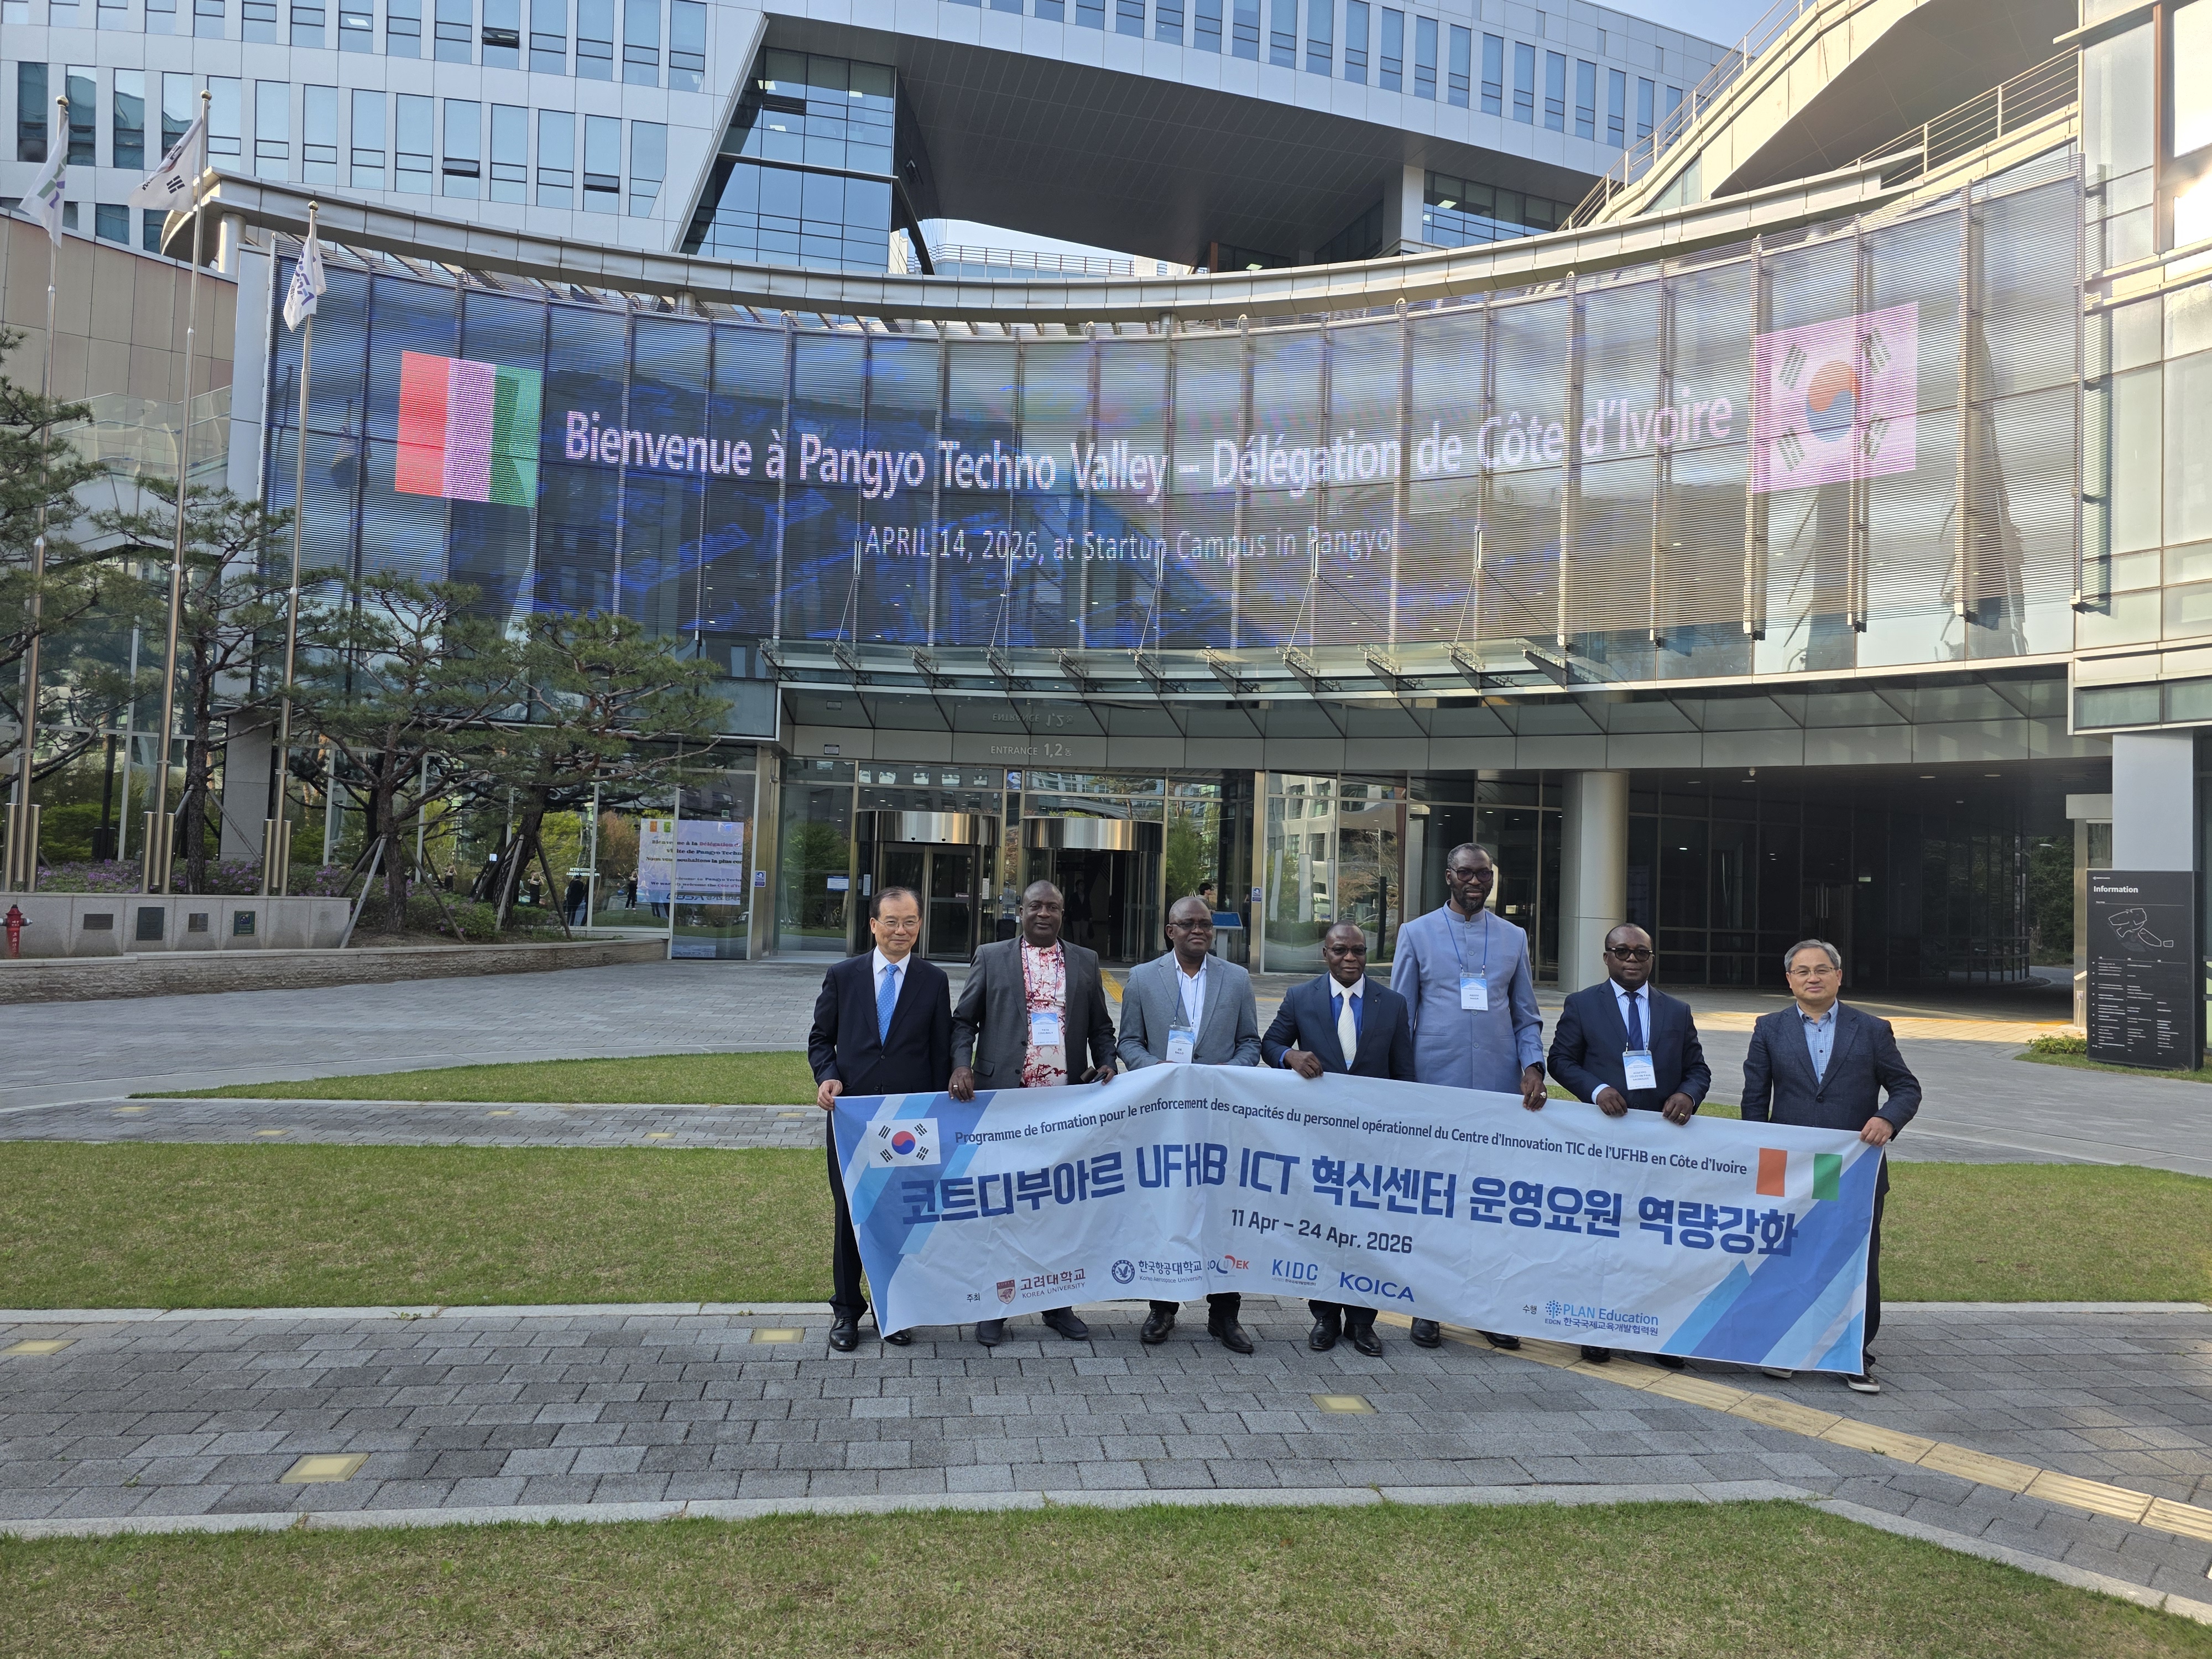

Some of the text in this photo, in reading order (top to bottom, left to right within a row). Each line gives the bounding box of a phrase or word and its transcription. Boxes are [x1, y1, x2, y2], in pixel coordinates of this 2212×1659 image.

[566, 410, 751, 477] Bienvenue
[765, 429, 785, 479] à
[800, 434, 925, 499] Pangyo
[941, 440, 1056, 491] Techno
[1071, 441, 1168, 502] Valley
[1213, 430, 1400, 498] Délégation
[1417, 420, 1463, 473] de
[1479, 413, 1563, 468] Côte
[1580, 387, 1732, 455] d'Ivoire
[865, 523, 1392, 568] APRIL 14, 2026, at Startup Campus in Pangyo
[990, 746, 1038, 755] ENTRANCE
[954, 1128, 1022, 1145] Programme
[1024, 1124, 1038, 1136] de
[1041, 1114, 1097, 1134] formation
[1099, 1110, 1126, 1126] pour
[1128, 1105, 1138, 1117] le
[1140, 1098, 1208, 1115] renforcement
[1211, 1098, 1230, 1112] des
[1232, 1104, 1285, 1120] capacités
[1287, 1108, 1301, 1122] du
[1303, 1113, 1360, 1129] personnel
[1362, 1118, 1432, 1138] opérationnel
[1434, 1126, 1448, 1140] du
[1451, 1128, 1489, 1145] Centre
[1491, 1132, 1562, 1153] d'Innovation
[1565, 1141, 1585, 1156] TIC
[1588, 1144, 1603, 1157] de
[1651, 1154, 1666, 1165] en
[1670, 1154, 1698, 1170] Côte
[1701, 1157, 1747, 1175] d'Ivoire
[901, 1142, 1799, 1258] 코트디부아르 UFHB ICT 혁신센터 운영요원 역량강화
[1232, 1209, 1244, 1227] 11
[1248, 1211, 1279, 1234] Apr
[1298, 1219, 1322, 1239] 24
[1326, 1227, 1361, 1248] Apr.
[1366, 1232, 1413, 1254] 2026
[1138, 1260, 1202, 1275] 한국항공대학교
[1272, 1259, 1318, 1281] KIDC
[1020, 1268, 1086, 1291] 고려대학교
[1022, 1282, 1086, 1298] KOREA UNIVERSITY
[1177, 1275, 1203, 1283] University
[1339, 1271, 1415, 1302] KOICA
[967, 1292, 980, 1302] 주최
[1522, 1304, 1537, 1315] 수행
[1563, 1303, 1658, 1326] PLAN Education
[1563, 1317, 1658, 1337] 한국국제교육개발협력원
